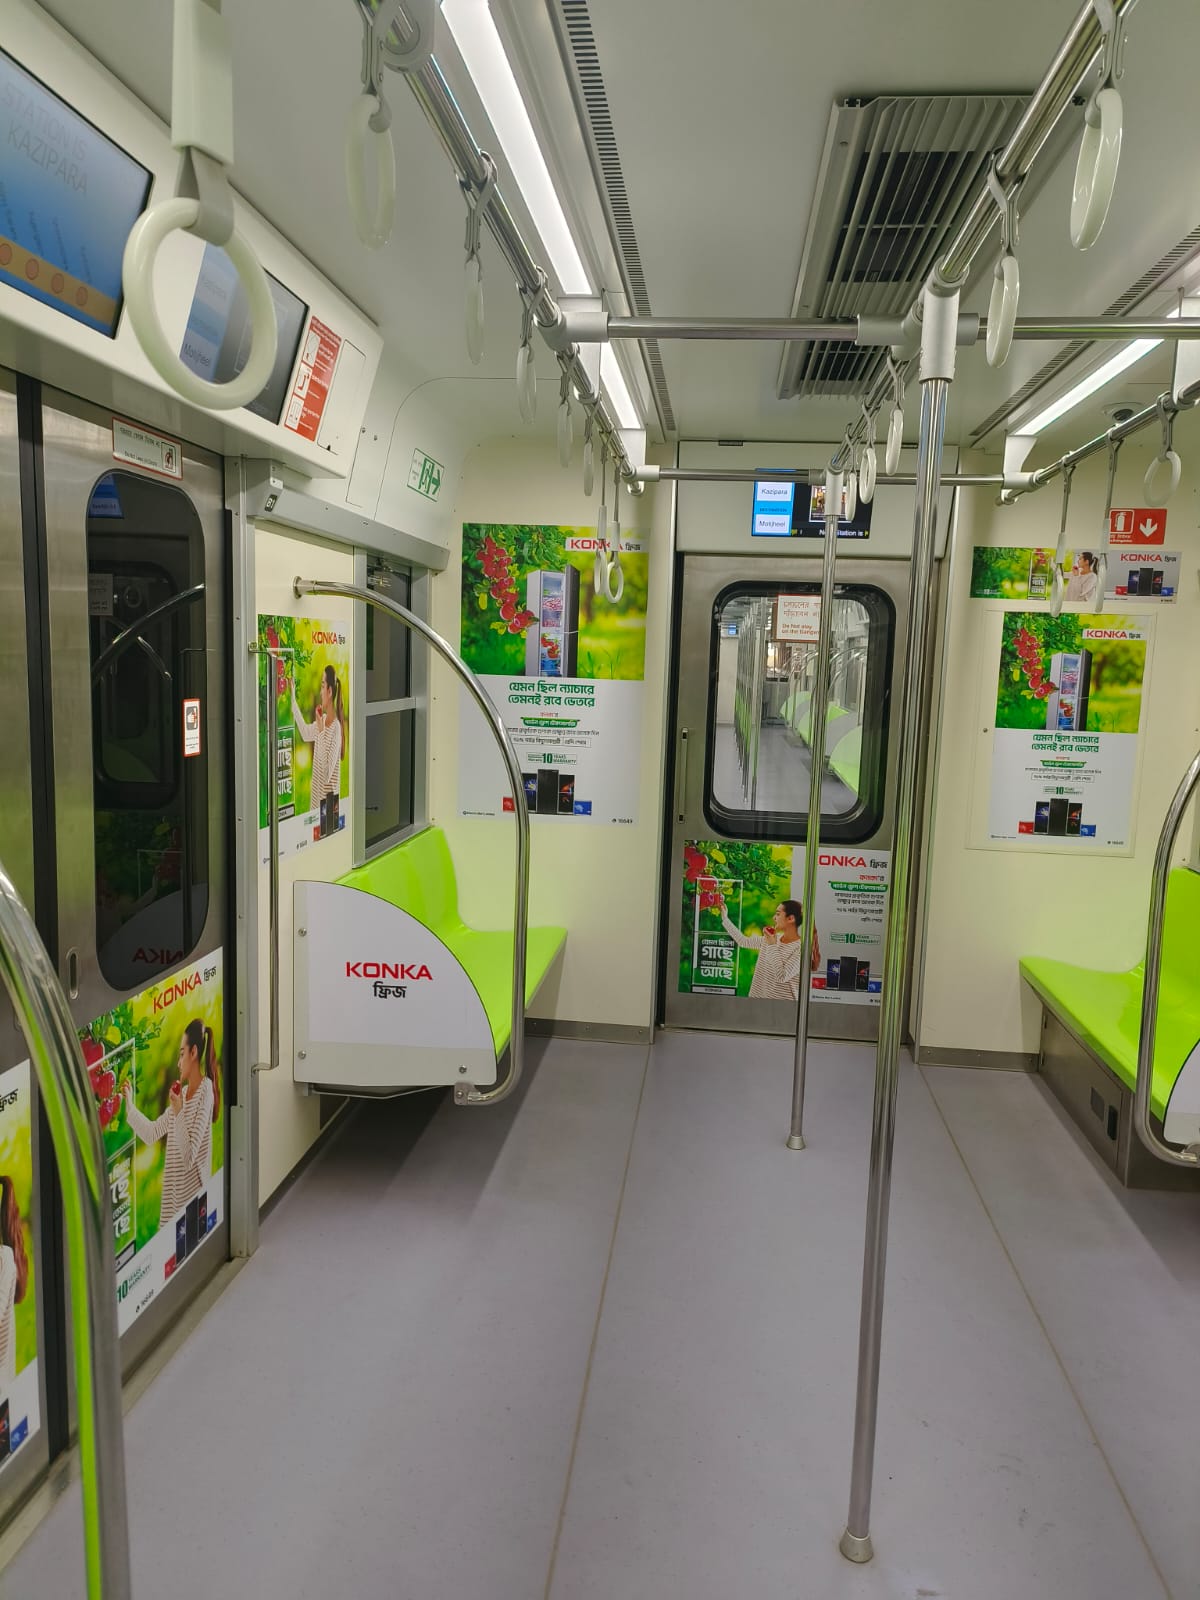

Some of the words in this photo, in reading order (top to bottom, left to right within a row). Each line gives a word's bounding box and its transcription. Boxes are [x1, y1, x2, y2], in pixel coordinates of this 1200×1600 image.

[8, 120, 88, 192] KAZIPARA
[761, 488, 788, 496] Kazipara
[759, 520, 786, 528] Motijheel
[1120, 553, 1162, 562] KONKA
[312, 631, 337, 645] KONKA
[1086, 630, 1127, 639] KONKA
[509, 682, 535, 692] যেমন
[537, 680, 557, 693] ছিল
[560, 684, 595, 695] ন্যাচারে
[508, 693, 541, 706] তেমনই
[543, 696, 561, 706] রবে
[564, 698, 595, 707] ভেতরে
[542, 753, 553, 764] 10
[1055, 786, 1065, 795] 10
[818, 854, 867, 868] ONKA
[844, 933, 856, 944] 10
[701, 945, 735, 962] গাছে
[346, 961, 433, 981] KONKA
[700, 966, 735, 980] আছে
[153, 971, 202, 1014] KONKA
[373, 981, 407, 999] ফ্রিজ
[117, 1280, 129, 1305] 10
